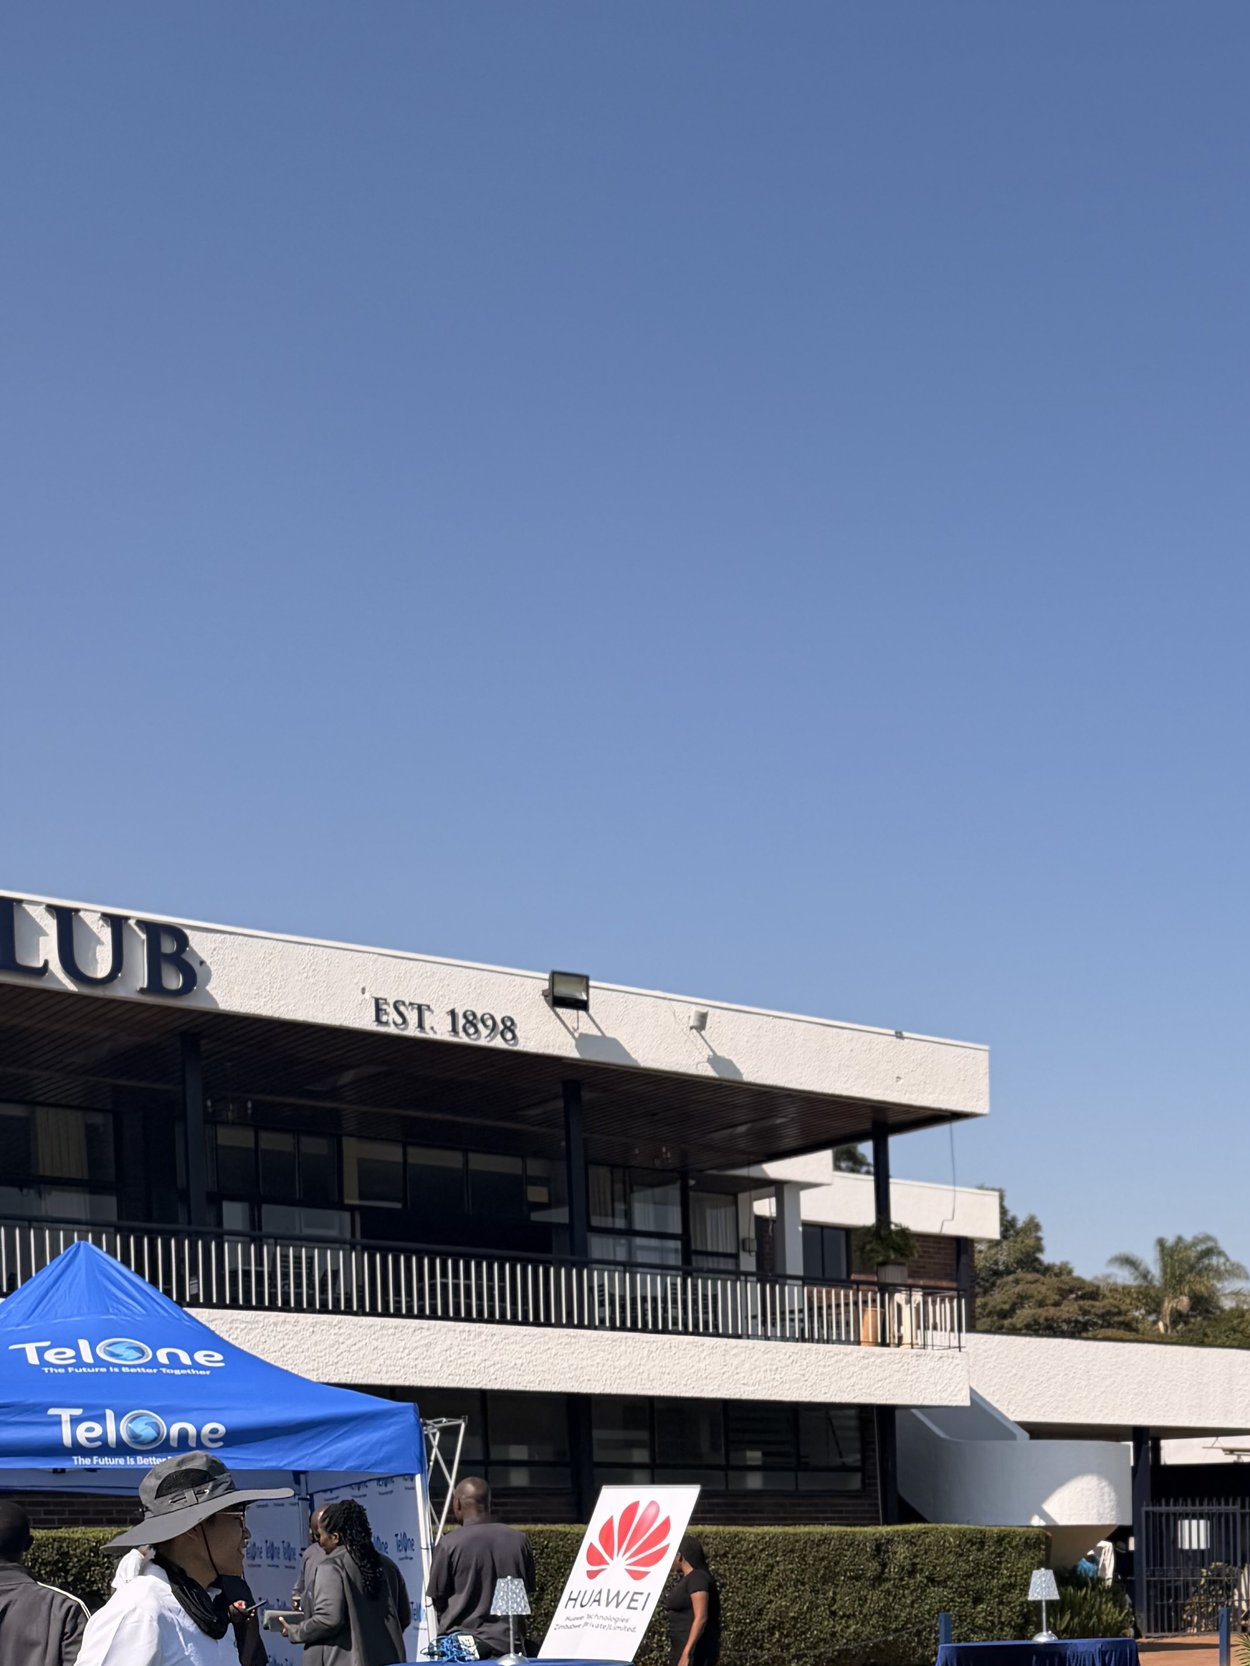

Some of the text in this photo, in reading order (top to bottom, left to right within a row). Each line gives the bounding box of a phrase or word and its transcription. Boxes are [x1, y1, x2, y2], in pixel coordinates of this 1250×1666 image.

[373, 996, 518, 1043] EST. 1898
[8, 1337, 226, 1367] TelOne
[41, 1366, 211, 1376] The Future Is Better Together
[46, 1407, 226, 1450] TelOne
[72, 1455, 91, 1465] The
[93, 1455, 124, 1465] Future
[127, 1455, 135, 1465] Is
[564, 1588, 651, 1612] HUAWEI
